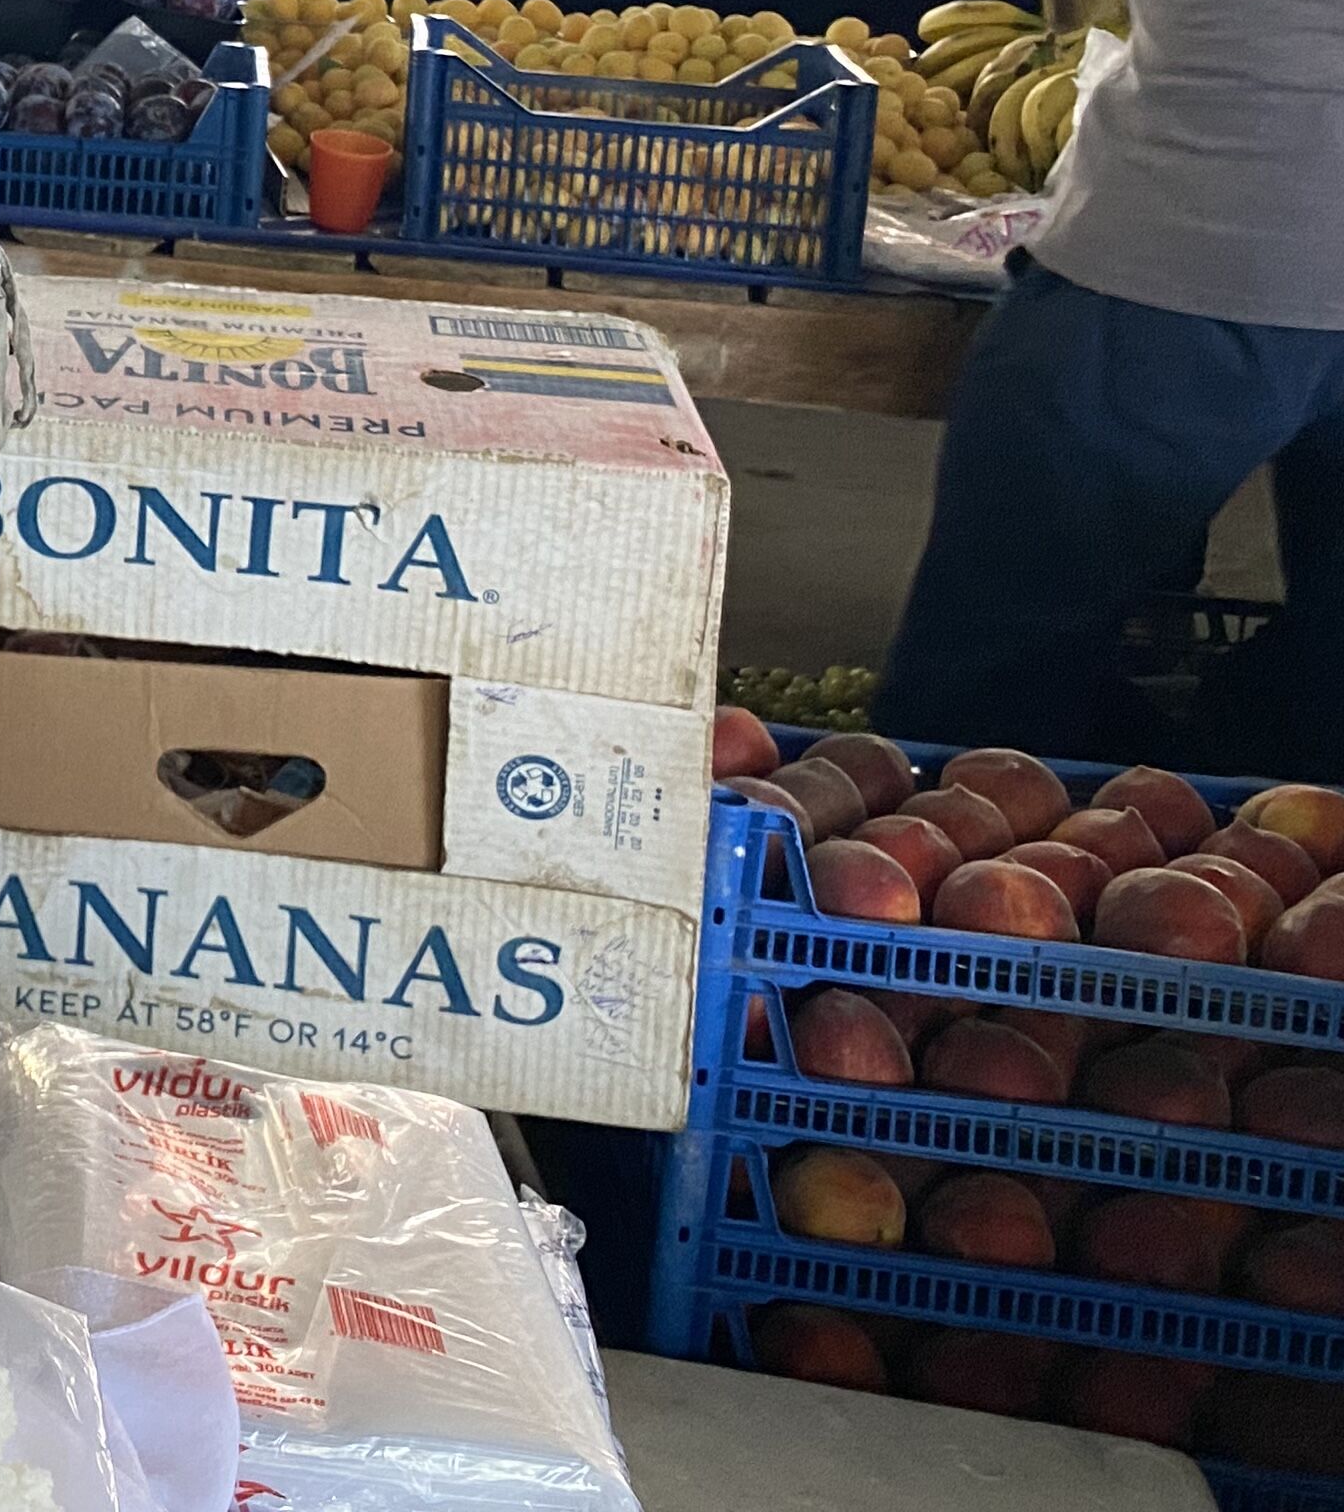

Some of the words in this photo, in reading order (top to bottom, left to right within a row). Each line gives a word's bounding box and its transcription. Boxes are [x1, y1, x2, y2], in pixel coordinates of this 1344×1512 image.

[66, 309, 209, 329] BANANAS
[222, 320, 364, 339] PREMIUM
[64, 326, 378, 395] BONITA
[175, 401, 426, 438] PREMIUM
[15, 984, 103, 1021] KEEP
[117, 998, 157, 1031] AT
[174, 1005, 254, 1041] 58°F
[267, 1019, 317, 1050] OR
[332, 1026, 416, 1061] 14°C
[175, 1101, 251, 1118] plastik
[207, 1289, 290, 1313] plastik
[255, 1361, 285, 1375] 300
